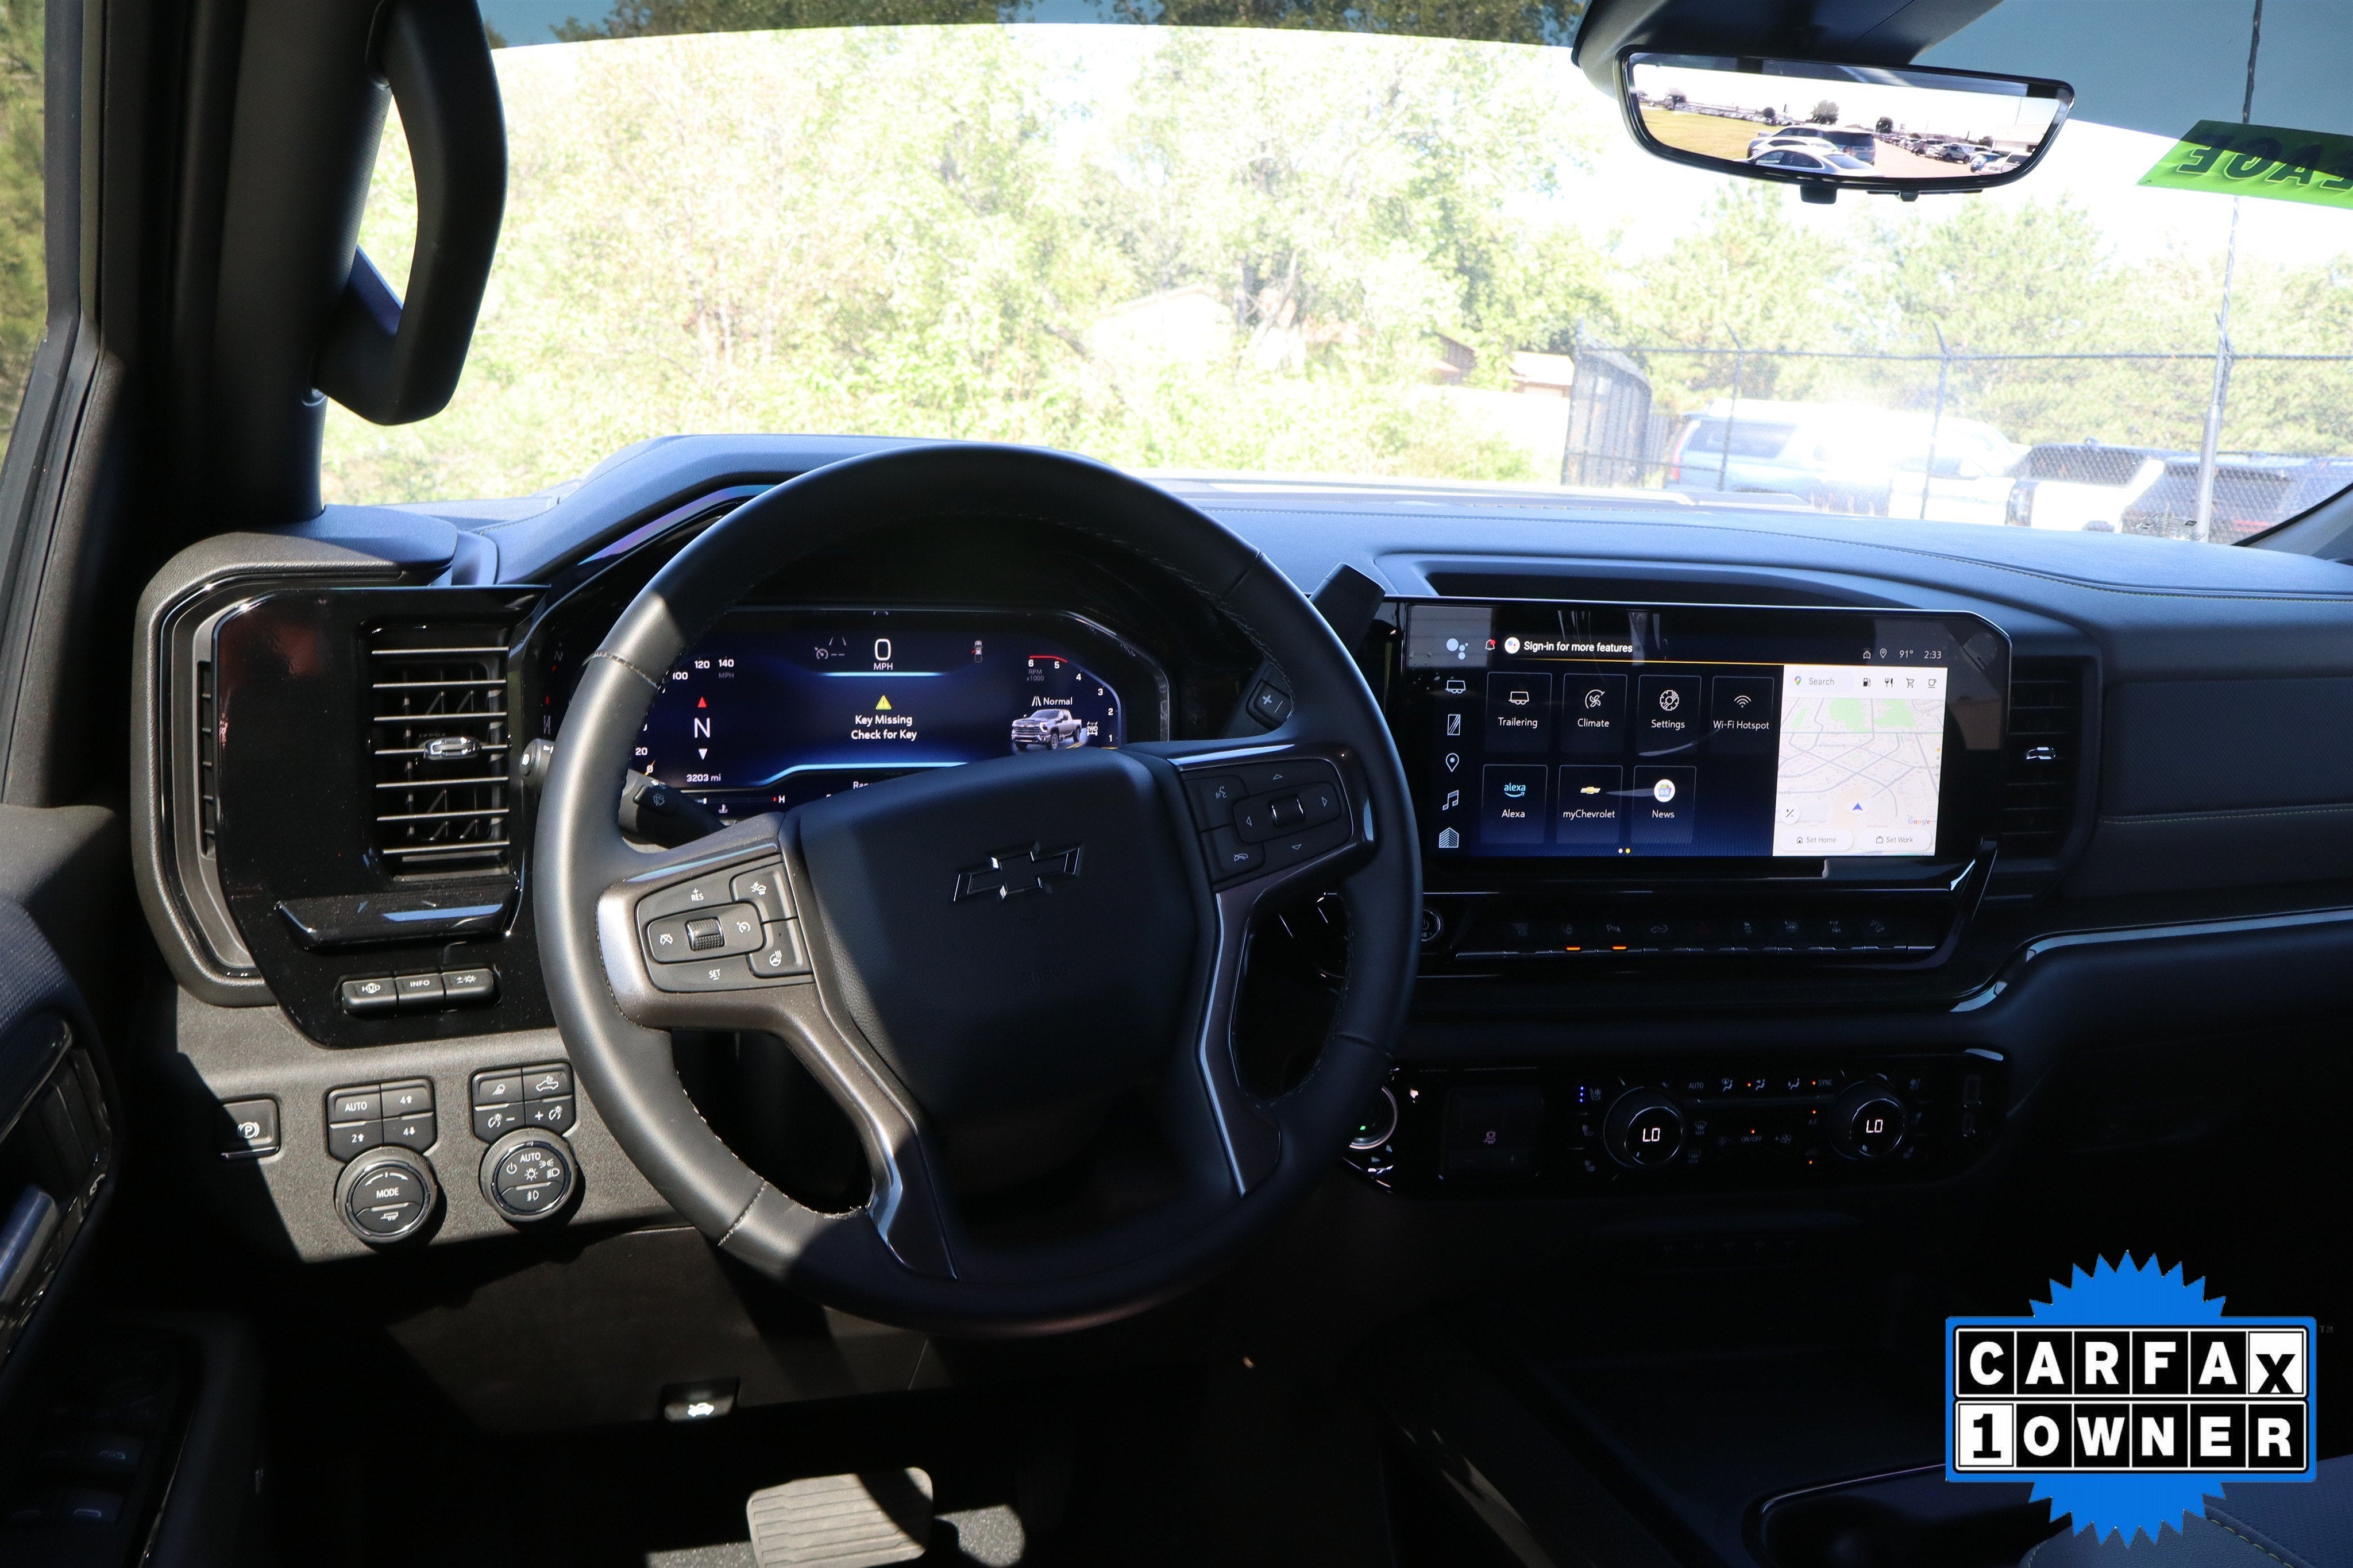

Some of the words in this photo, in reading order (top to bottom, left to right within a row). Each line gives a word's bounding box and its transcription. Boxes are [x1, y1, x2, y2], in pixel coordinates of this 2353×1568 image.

[874, 639, 891, 661] 0
[1523, 641, 1554, 653] Sign-in
[1556, 642, 1569, 651] for
[1571, 644, 1595, 652] more
[1596, 642, 1633, 653] features
[1924, 650, 1942, 659] 2:33
[694, 661, 710, 669] 120
[718, 659, 734, 667] 140
[874, 663, 893, 671] MPH
[1028, 659, 1035, 667] 6
[1054, 661, 1060, 669] 5
[673, 671, 688, 680] 100
[1075, 673, 1082, 681] 4
[1808, 678, 1835, 686] Search
[1097, 688, 1104, 696] 3
[1043, 697, 1073, 705] Normal
[1108, 708, 1114, 716] 2
[855, 715, 873, 727] Key
[875, 715, 913, 727] Missing
[1498, 717, 1538, 729] Trailering
[1577, 718, 1610, 728] Climate
[1651, 719, 1686, 731] Settings
[693, 717, 711, 739] N
[1712, 720, 1734, 729] Wi-Fi
[1736, 720, 1770, 732] Hotspot
[851, 729, 881, 740] Check
[883, 729, 897, 739] for
[900, 729, 917, 741] Key
[635, 747, 648, 756] 20
[686, 773, 709, 782] 3203
[711, 773, 722, 782] mi
[1504, 783, 1526, 791] alexa
[778, 795, 785, 803] H
[1502, 809, 1525, 818] Alexa
[1563, 809, 1615, 820] myChevrolet
[1652, 810, 1675, 819] News
[1908, 818, 1930, 827] Google
[1898, 835, 1914, 843] Work
[708, 969, 720, 978] SET
[410, 979, 430, 987] INFO
[1688, 1082, 1704, 1090] AUTO
[1818, 1078, 1833, 1087] SYNC
[345, 1101, 368, 1112] AUTO
[1741, 1136, 1764, 1144] ON/OFF
[520, 1152, 541, 1163] AUTO
[376, 1187, 400, 1199] MODE
